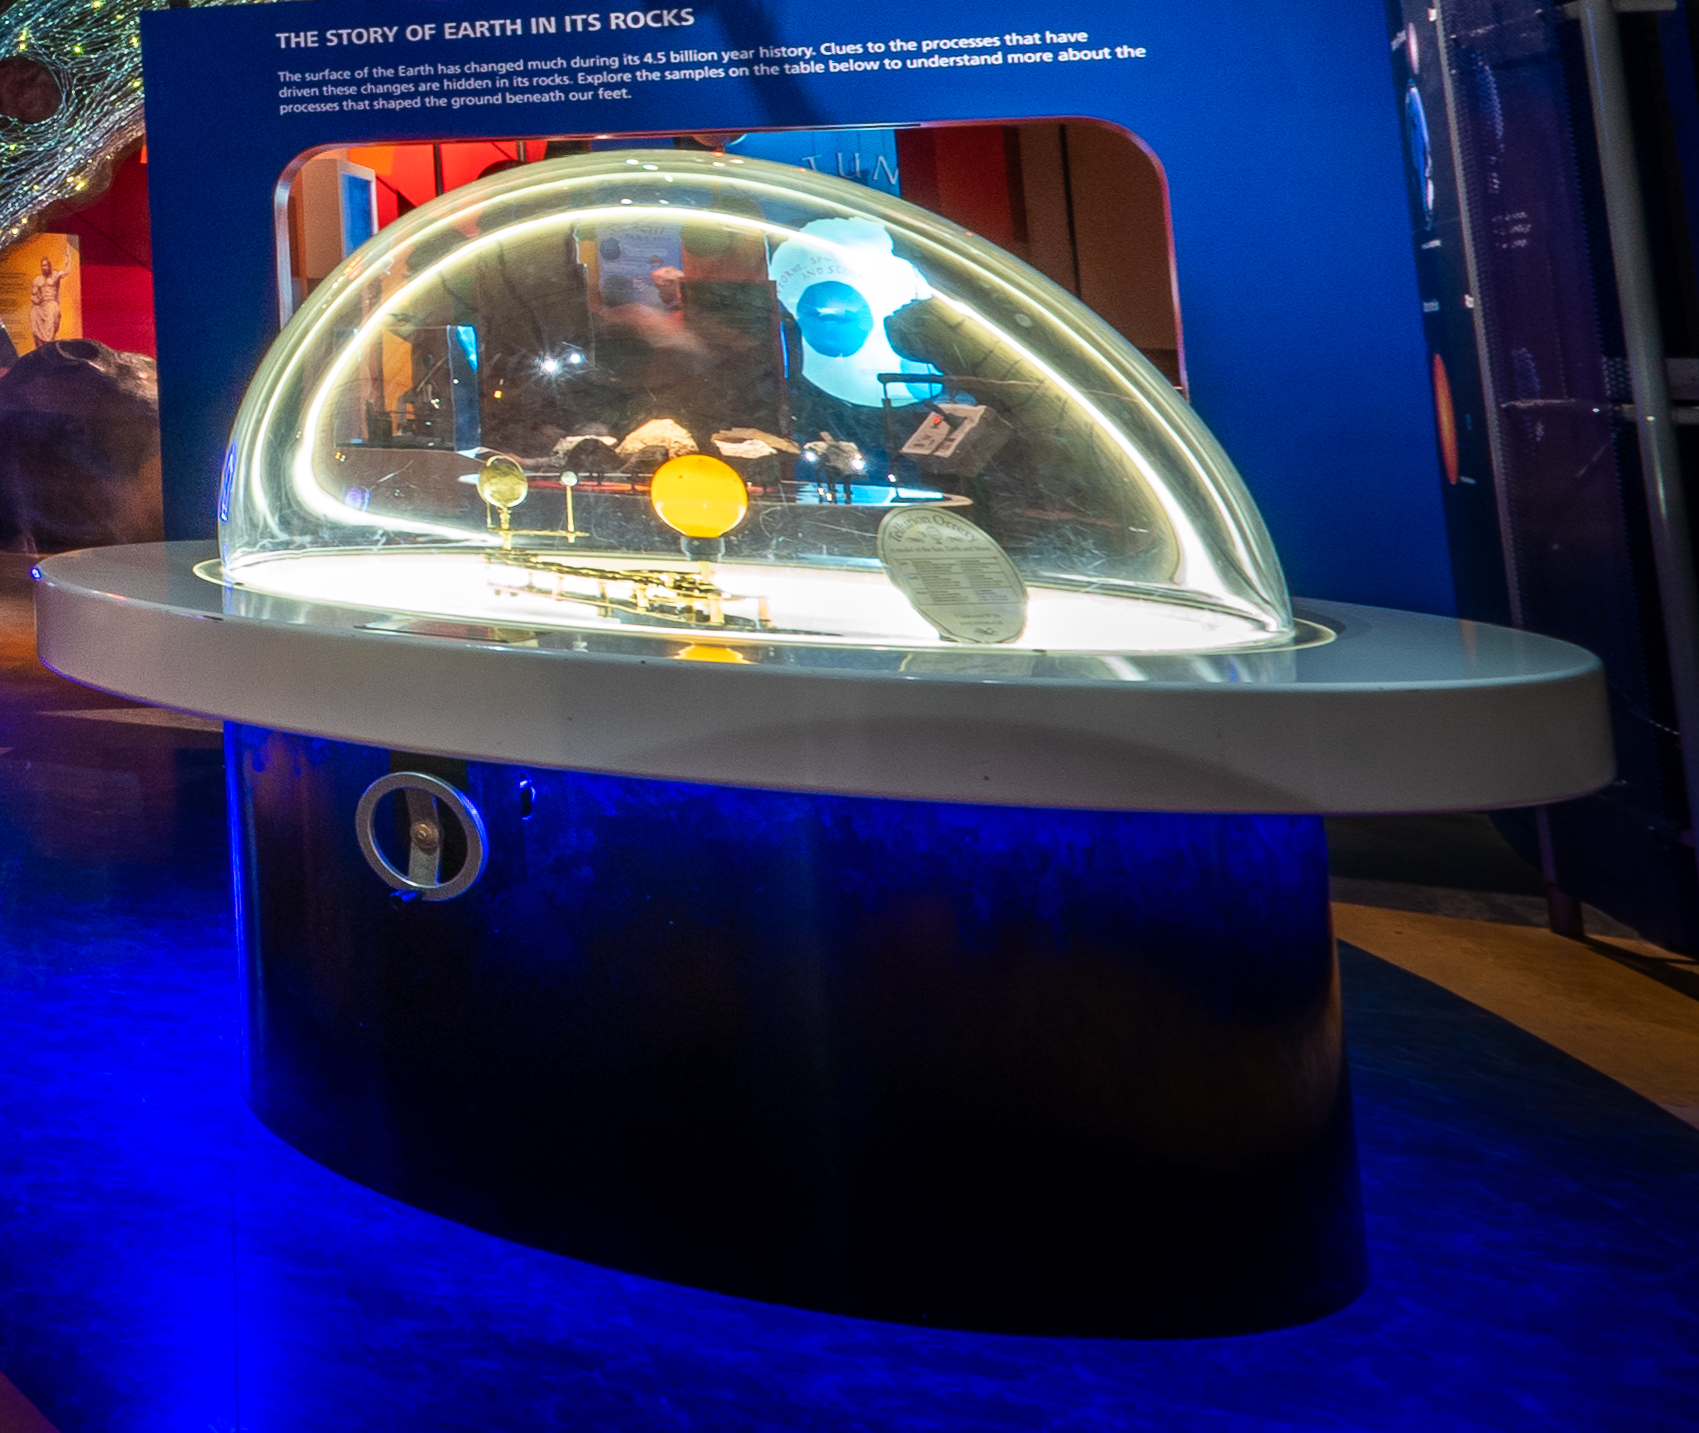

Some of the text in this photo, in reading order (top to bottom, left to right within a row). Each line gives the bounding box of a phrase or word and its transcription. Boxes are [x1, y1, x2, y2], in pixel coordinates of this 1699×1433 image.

[275, 7, 695, 49] THE STORY OF EARTH IN ITS ROCKS
[277, 30, 1089, 83] The surface of the Earth has changed much during its 4.5 billion year history. Clues to the processes that have
[278, 44, 1147, 99] driven these changes are hidden in its rocks. Explore the samples on the table below to understand more about the
[279, 87, 632, 116] processes that shaped the ground beneath our feet.
